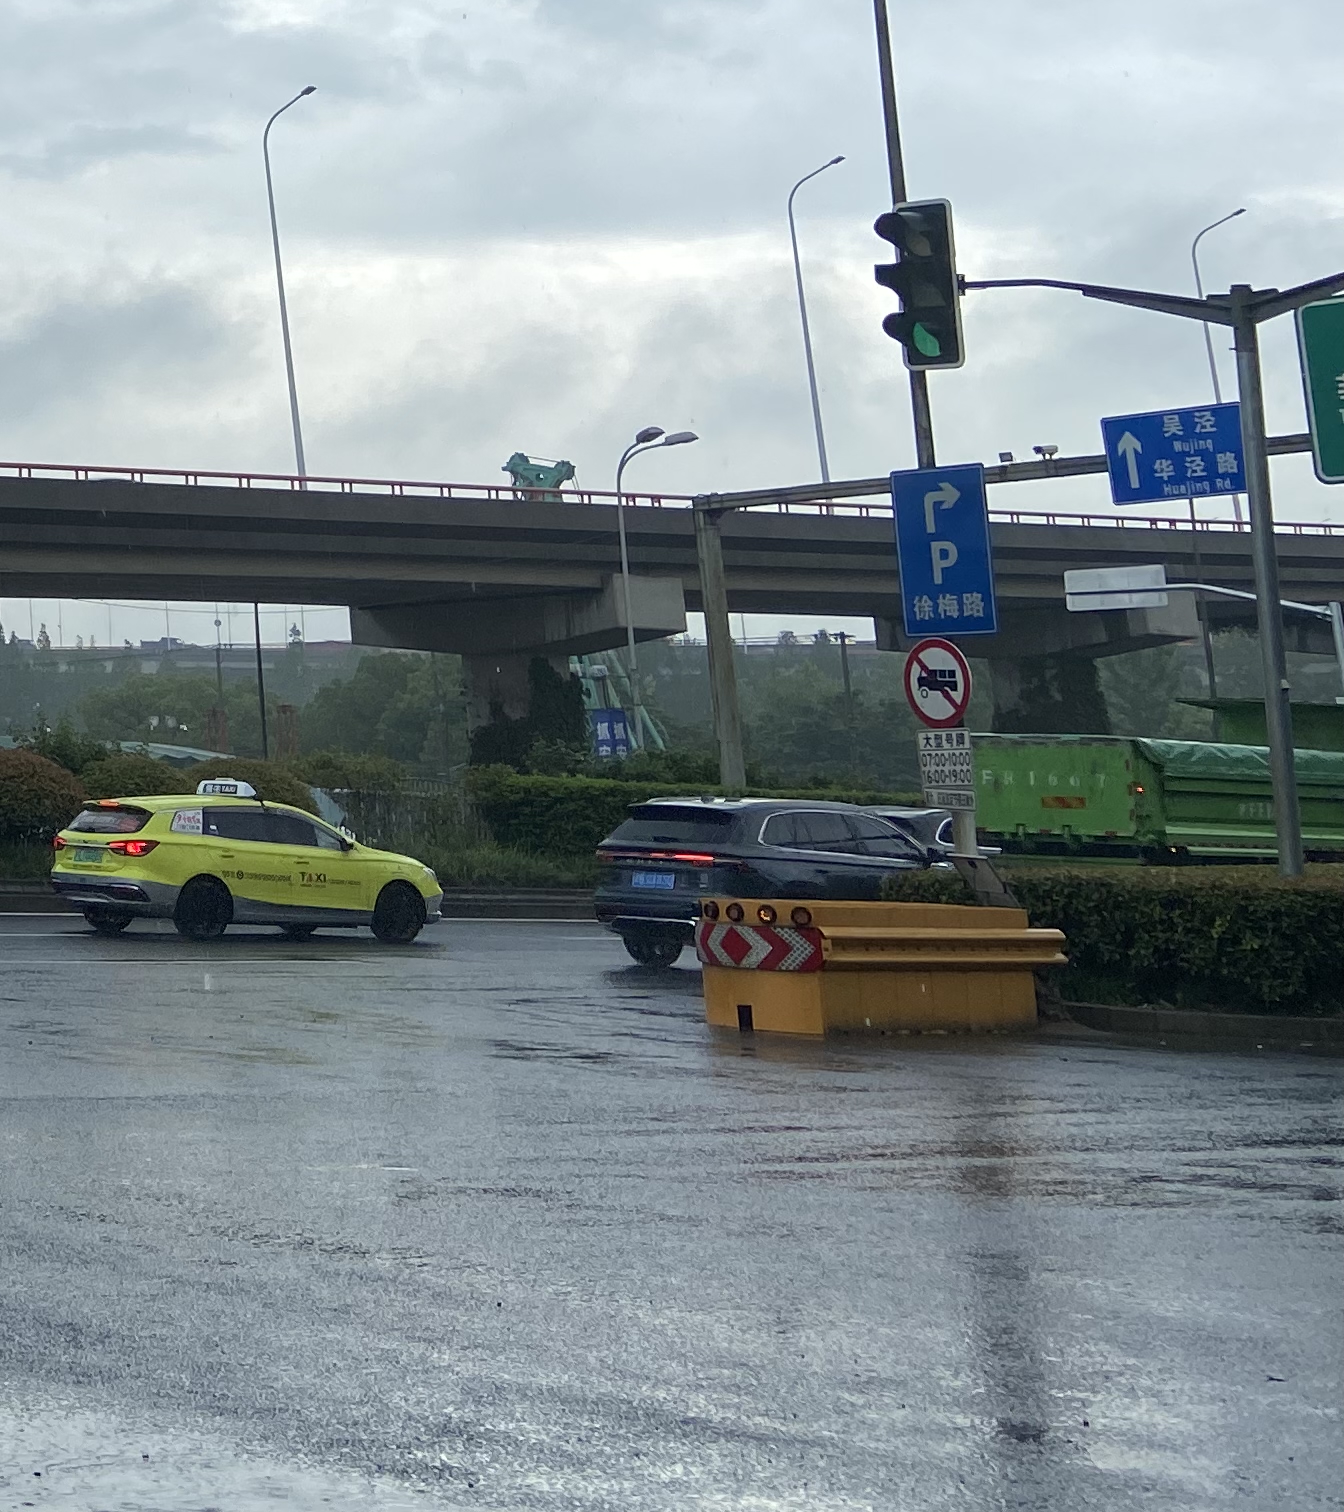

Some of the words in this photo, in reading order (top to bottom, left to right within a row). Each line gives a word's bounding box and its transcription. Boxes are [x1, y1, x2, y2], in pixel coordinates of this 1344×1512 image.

[1162, 411, 1217, 437] 吴泾
[1173, 438, 1213, 454] Wujing
[1153, 452, 1238, 480] 华泾路
[1163, 480, 1210, 496] Huajing
[930, 540, 958, 585] P
[913, 592, 984, 620] 徐梅路
[299, 871, 327, 883] TAXI
